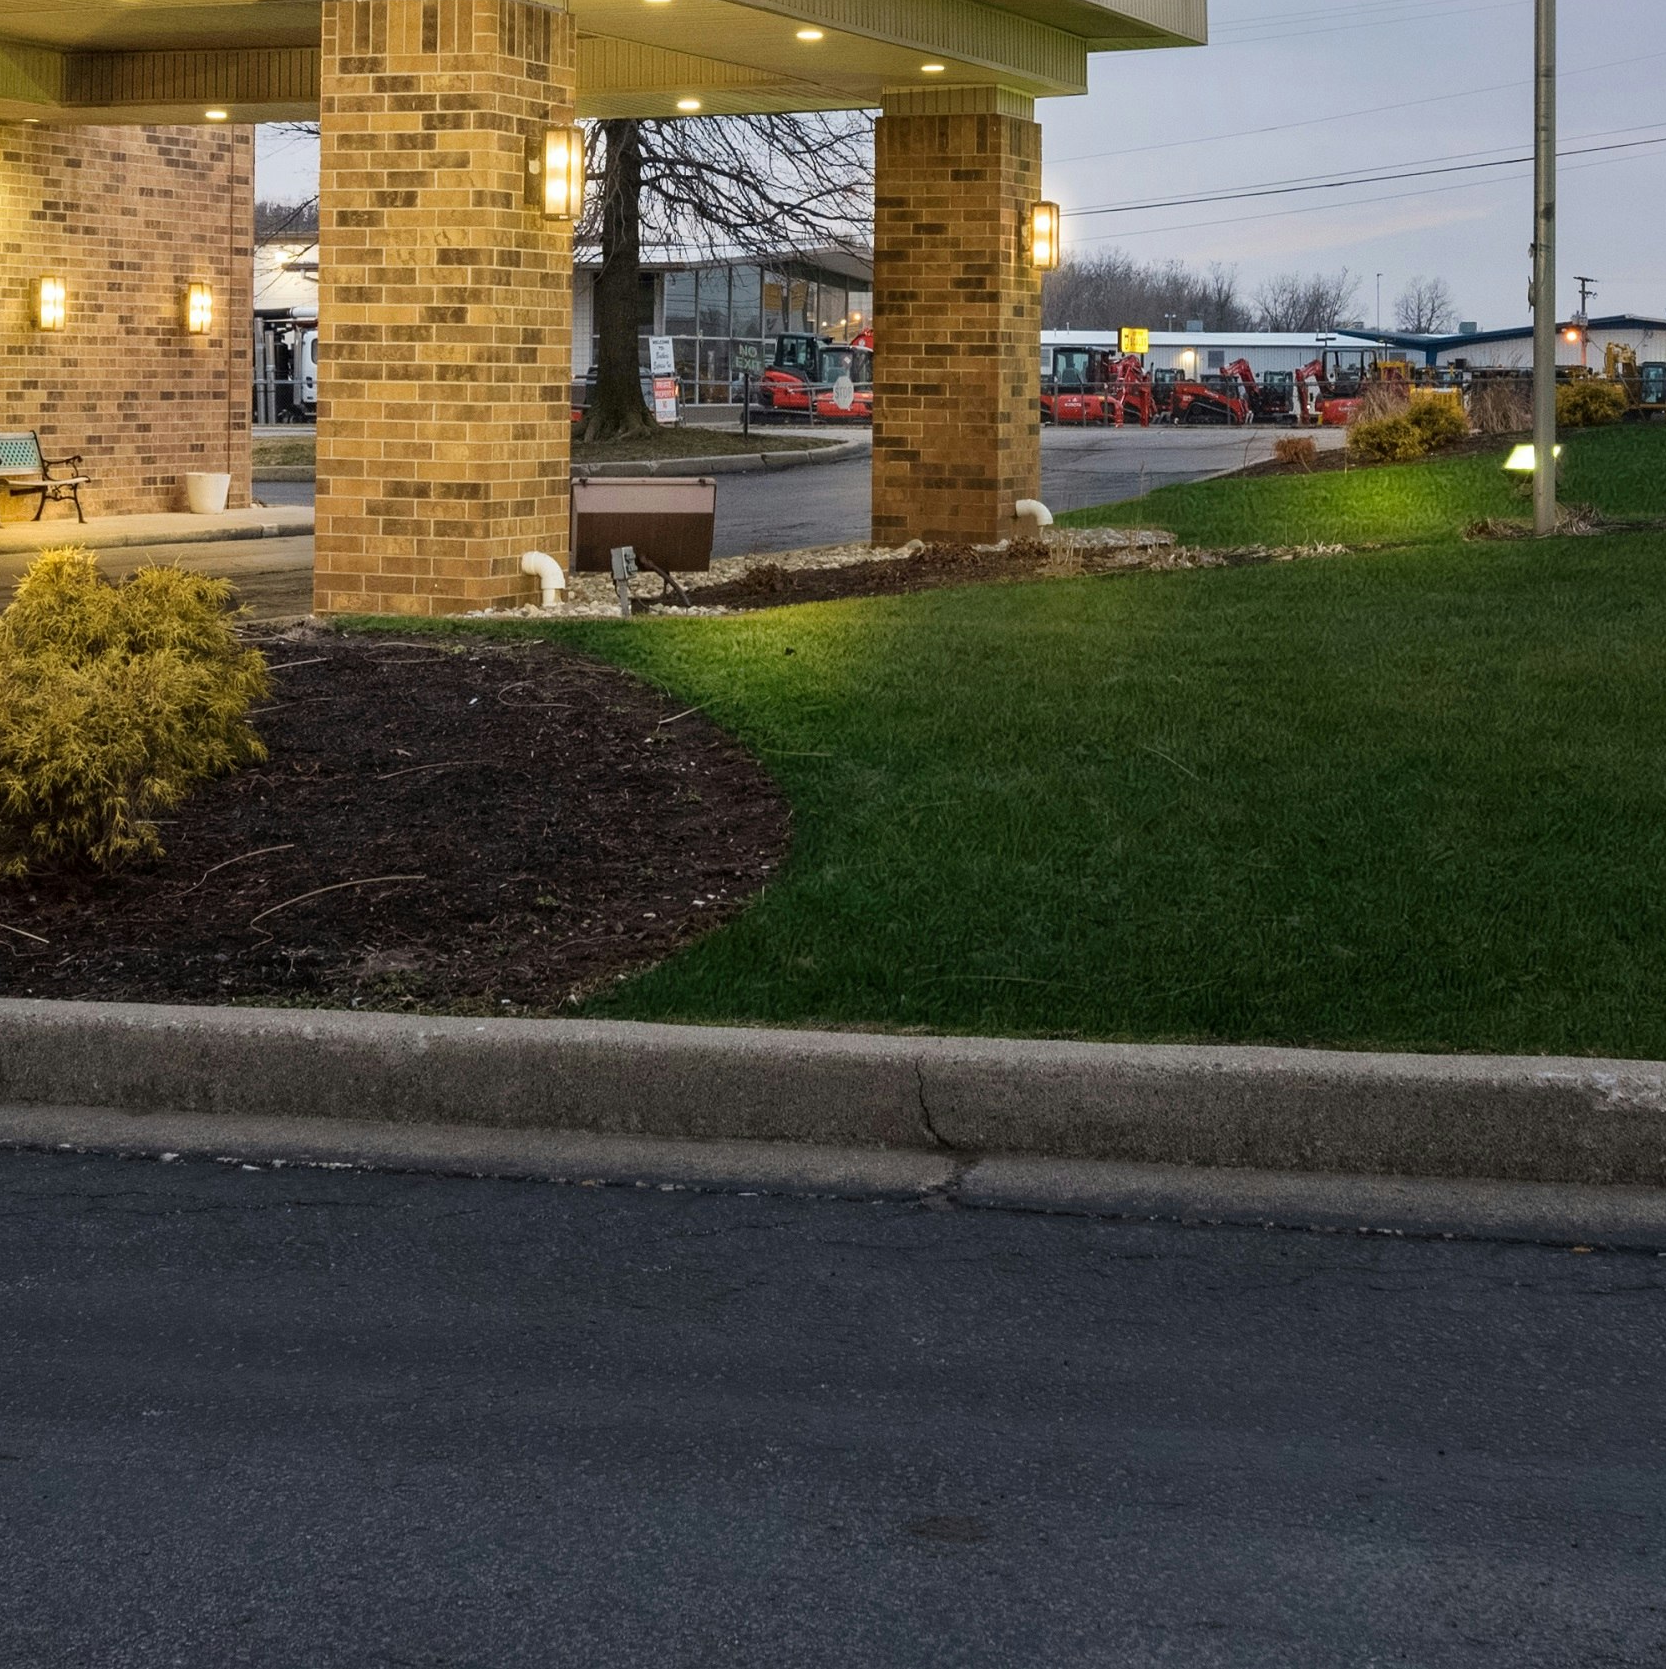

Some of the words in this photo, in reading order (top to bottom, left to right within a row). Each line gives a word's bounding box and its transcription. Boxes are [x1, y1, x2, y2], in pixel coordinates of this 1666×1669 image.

[739, 344, 757, 357] NO
[735, 357, 761, 370] EXIT
[835, 385, 853, 399] STOP
